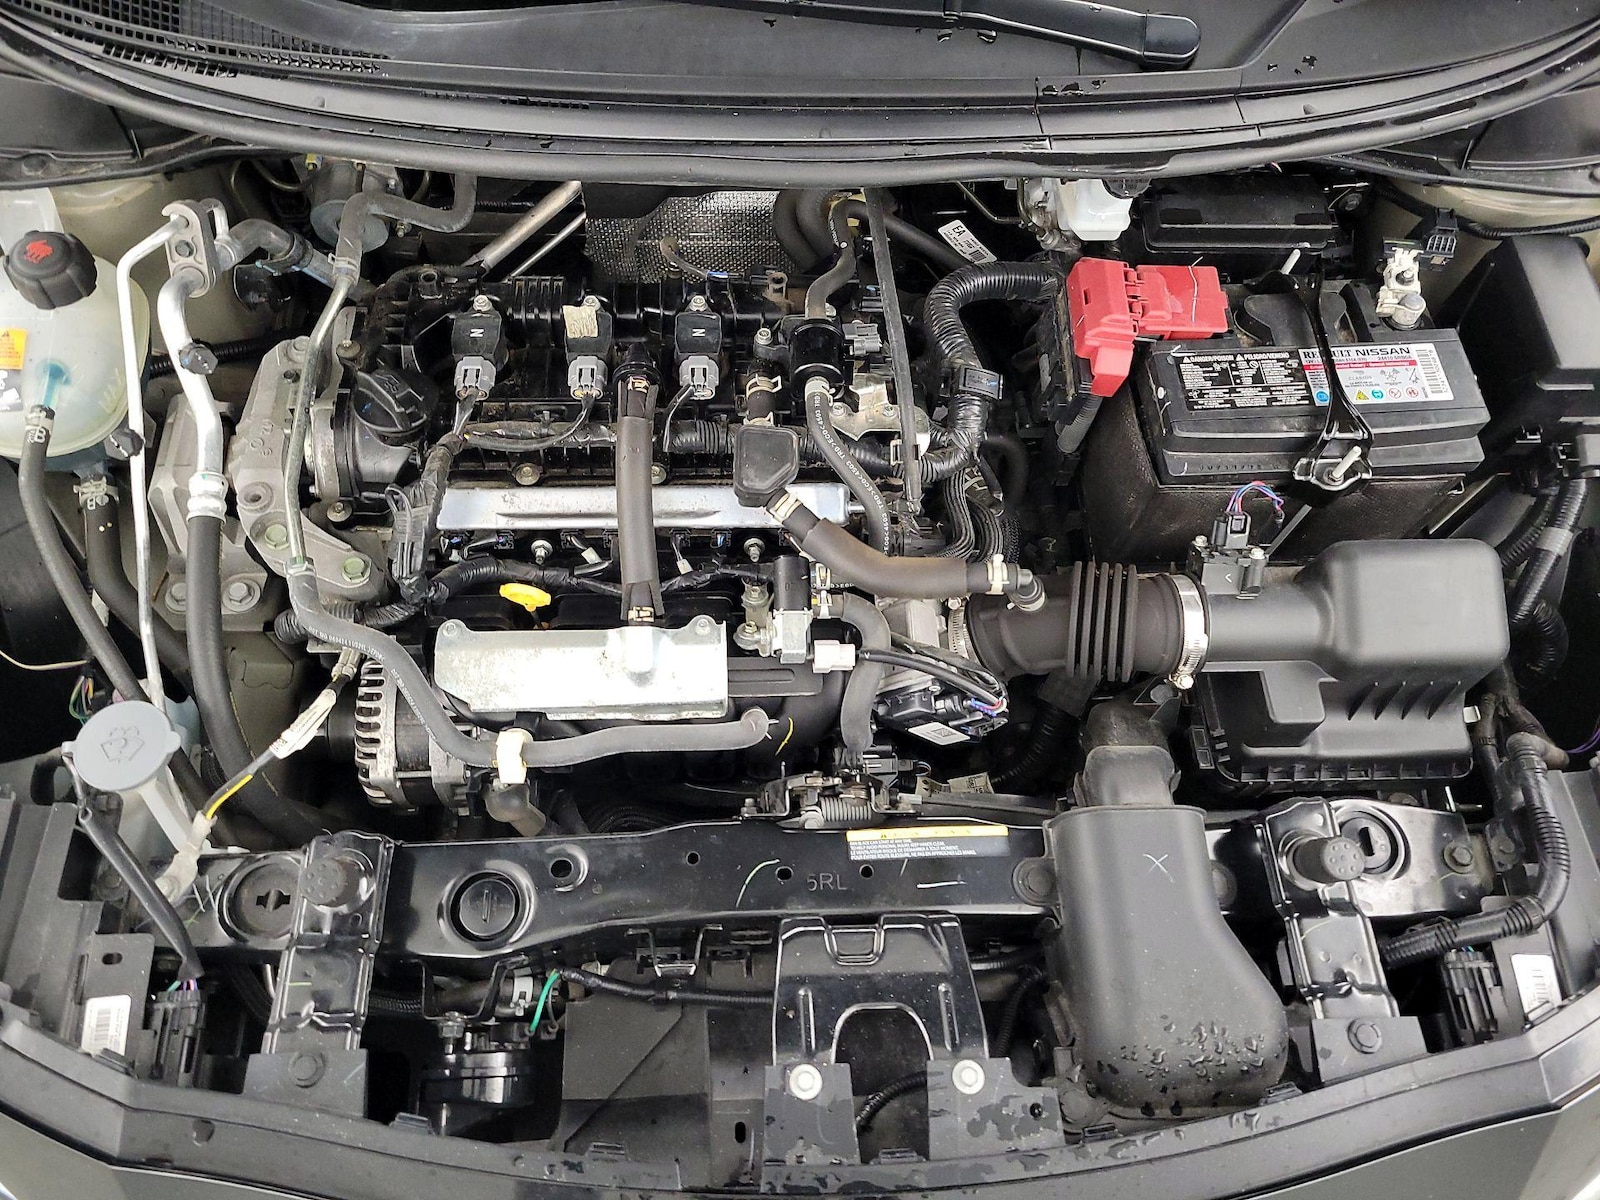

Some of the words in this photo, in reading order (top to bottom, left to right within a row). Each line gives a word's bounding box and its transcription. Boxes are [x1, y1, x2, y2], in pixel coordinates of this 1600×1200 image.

[952, 225, 966, 237] EA
[1356, 347, 1410, 357] NISSAN
[806, 872, 847, 892] 5RL
